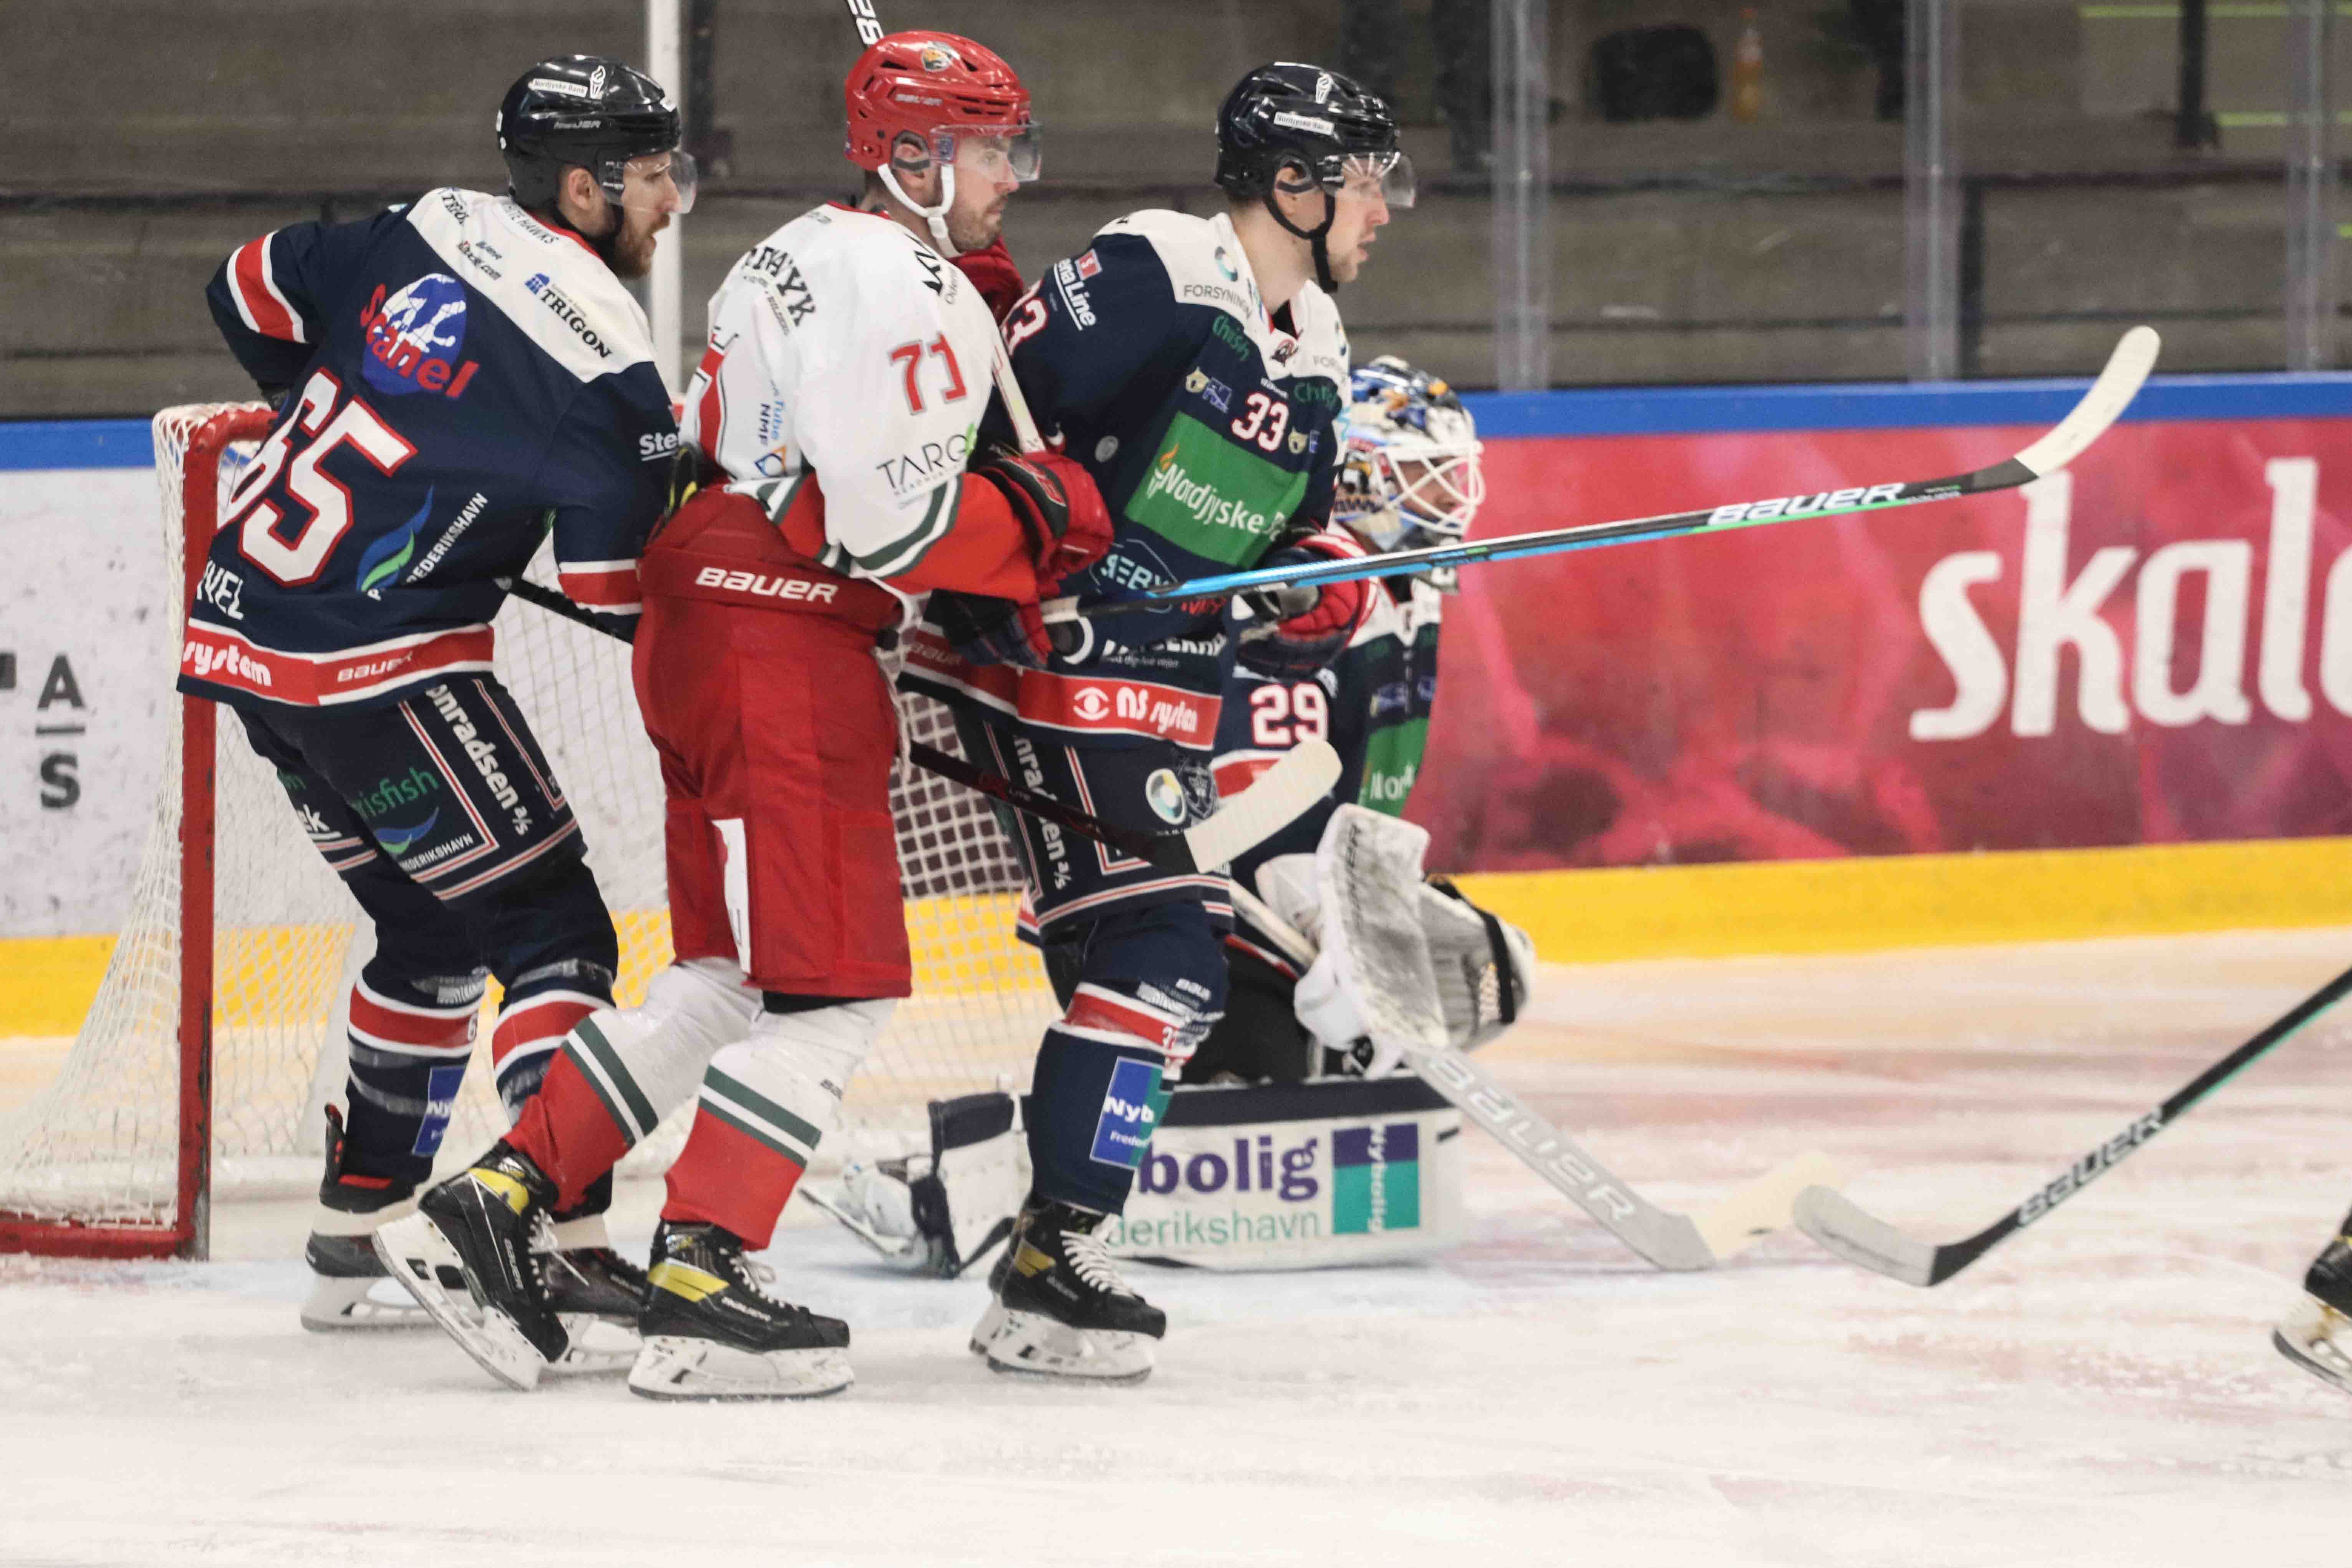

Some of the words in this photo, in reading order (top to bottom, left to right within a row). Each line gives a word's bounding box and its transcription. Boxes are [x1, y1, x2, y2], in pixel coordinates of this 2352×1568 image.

[540, 289, 613, 358] TRIGON
[888, 331, 968, 416] 71
[1232, 391, 1290, 452] 33
[216, 367, 418, 587] 65
[1707, 482, 1906, 526] BAUER
[695, 567, 839, 604] BAUER
[184, 641, 272, 687] system
[1248, 681, 1328, 746] 29
[1138, 1134, 1319, 1202] bolig
[2018, 1111, 2161, 1226] BAUER
